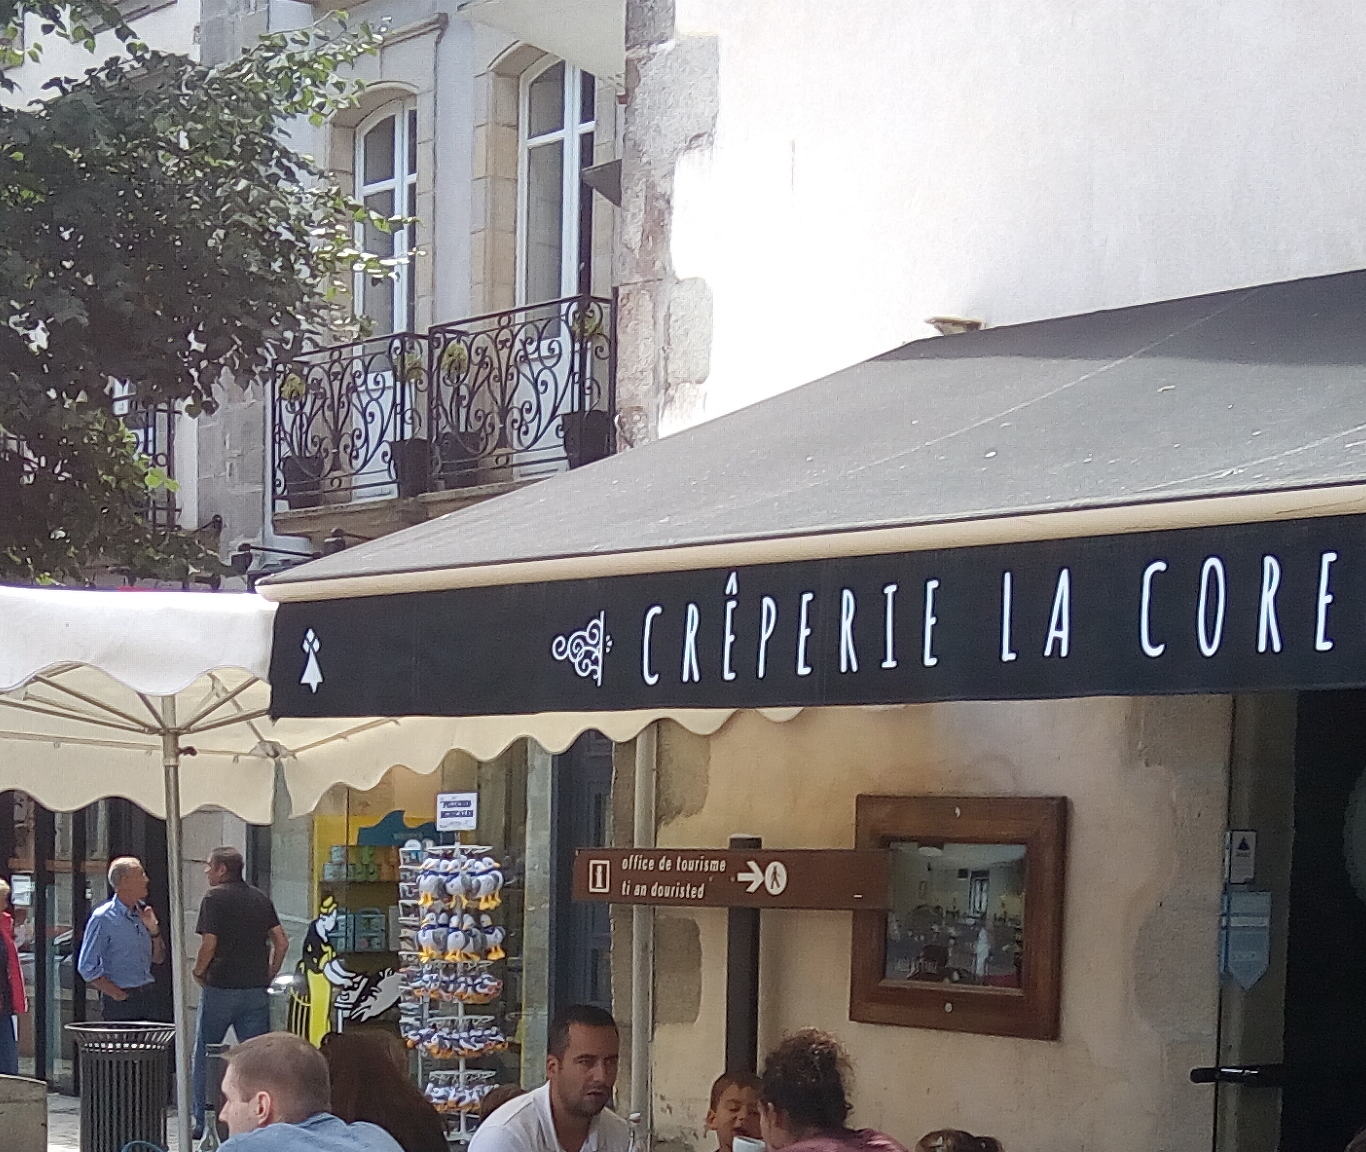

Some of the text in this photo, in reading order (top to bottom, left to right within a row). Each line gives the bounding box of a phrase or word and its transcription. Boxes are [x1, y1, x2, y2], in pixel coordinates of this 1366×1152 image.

[642, 571, 940, 687] CRÊPERIE
[1000, 567, 1071, 663] LA
[620, 853, 727, 873] office de tourisme
[620, 879, 706, 899] ti an douristed
